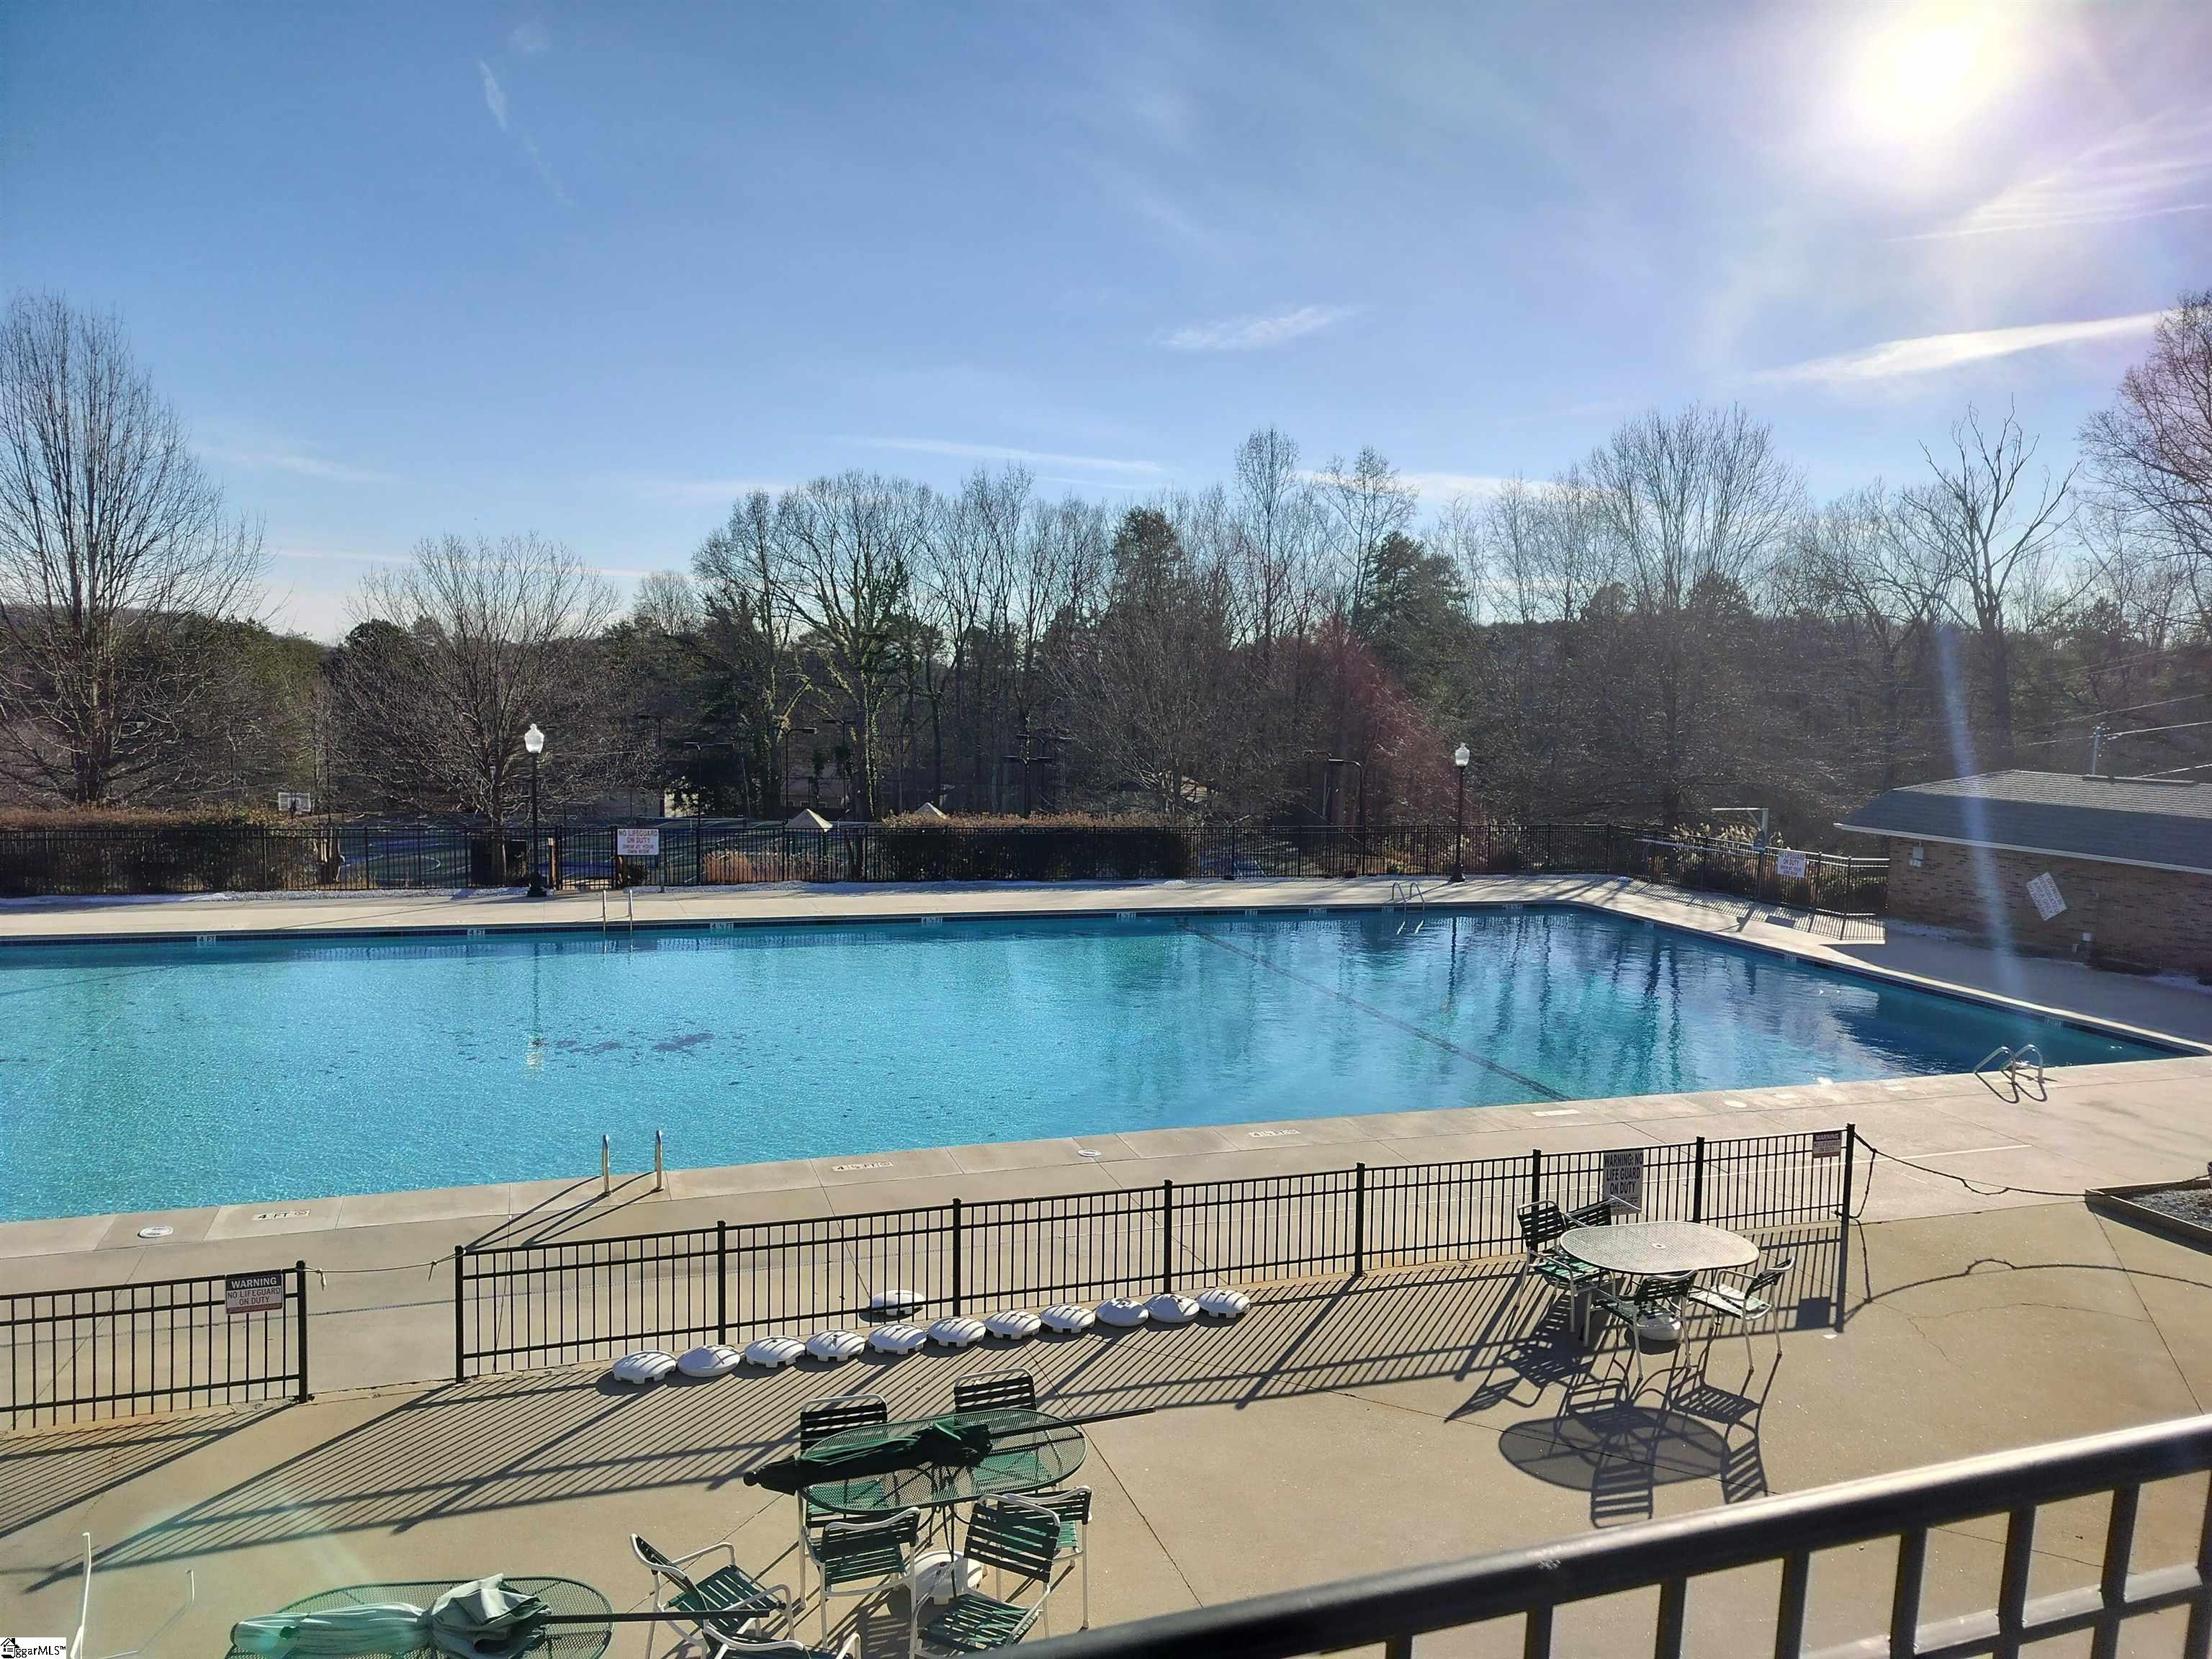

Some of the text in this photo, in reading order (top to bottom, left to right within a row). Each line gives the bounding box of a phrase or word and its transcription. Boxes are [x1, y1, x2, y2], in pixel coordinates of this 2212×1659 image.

[1604, 1153, 1643, 1166] WARNING: NO
[1606, 1166, 1640, 1182] LIFE GUARD
[1610, 1180, 1636, 1195] ON DUTY
[231, 1277, 277, 1289] WARNING
[240, 1287, 281, 1298] LIFEGUARD
